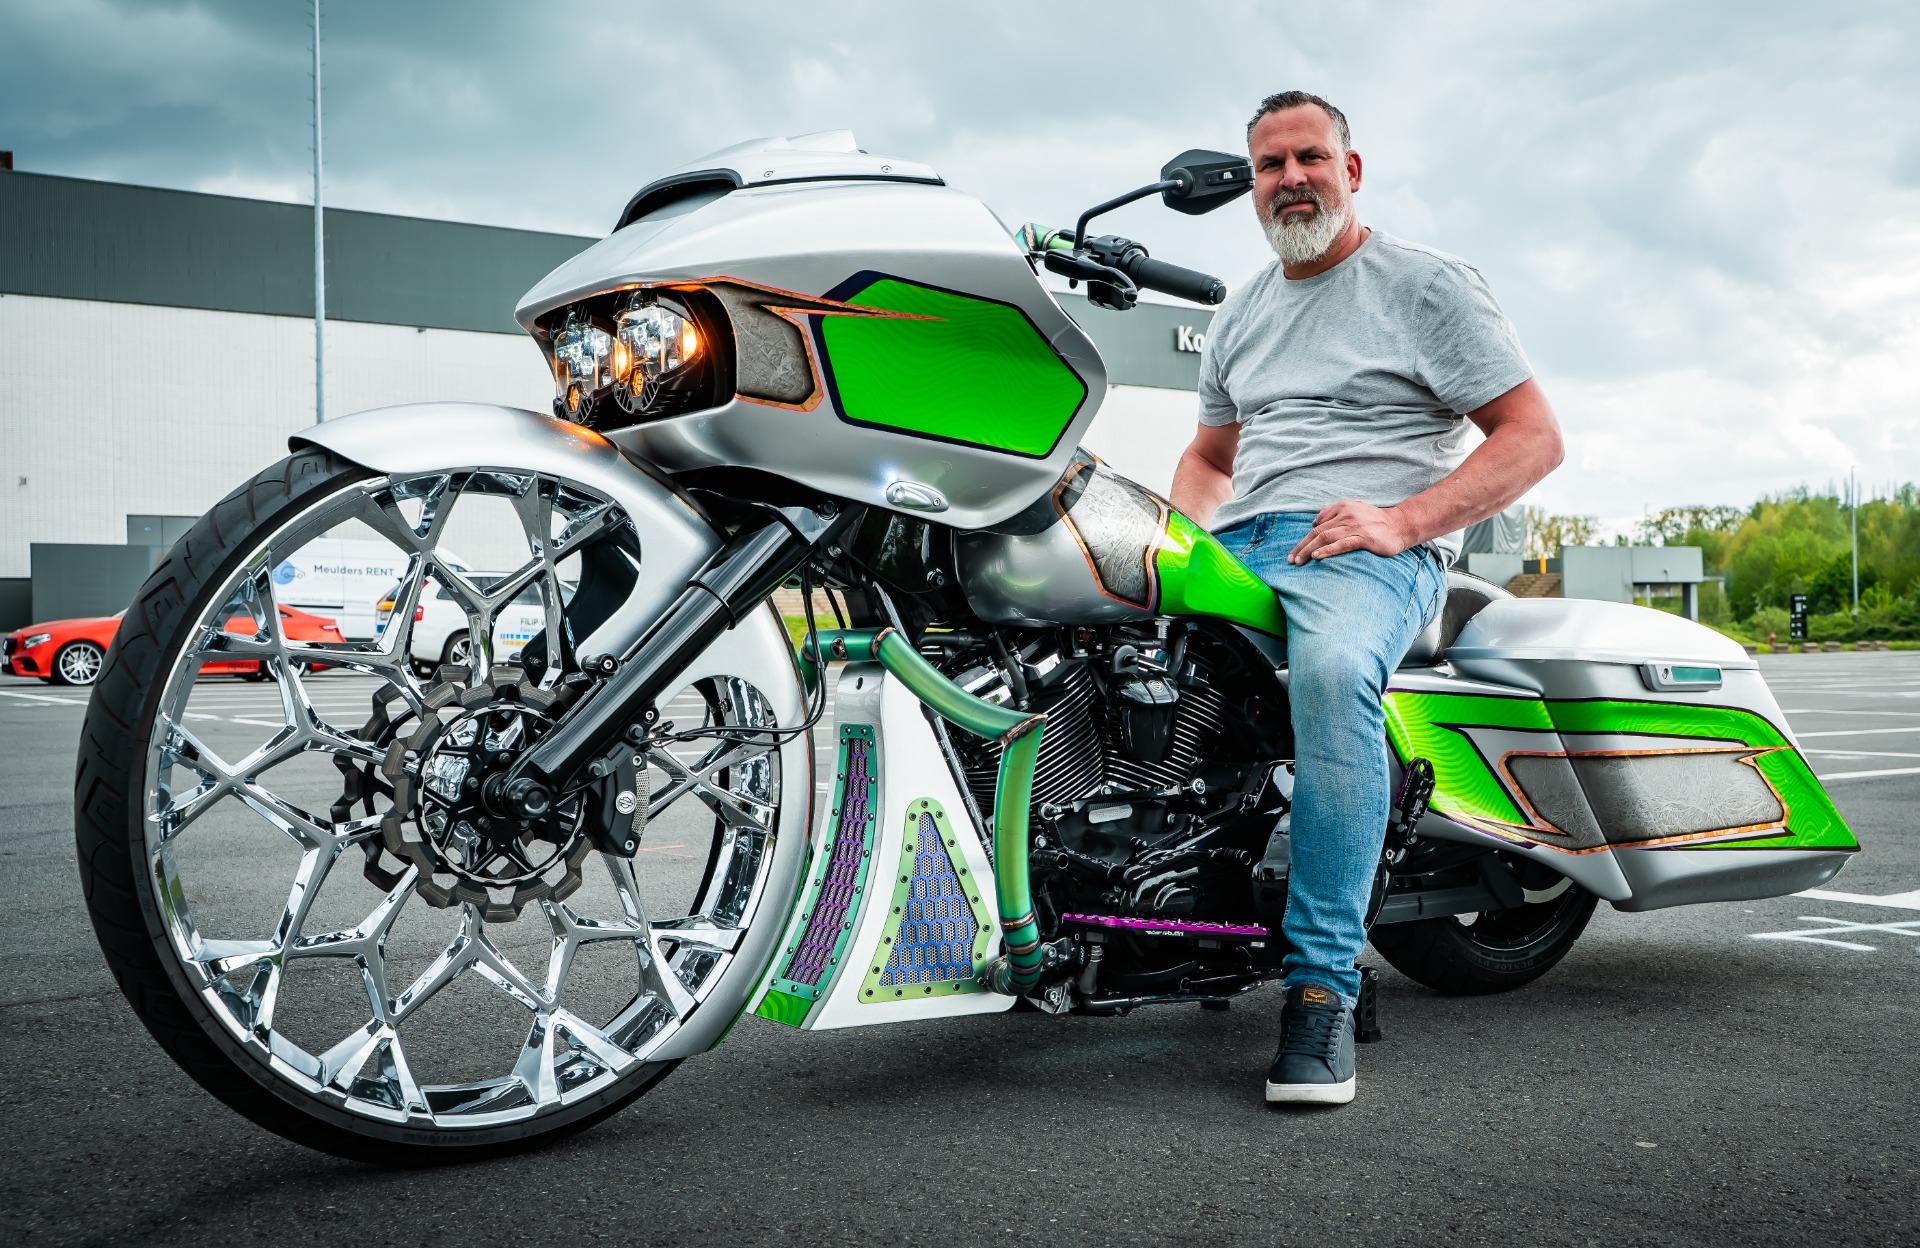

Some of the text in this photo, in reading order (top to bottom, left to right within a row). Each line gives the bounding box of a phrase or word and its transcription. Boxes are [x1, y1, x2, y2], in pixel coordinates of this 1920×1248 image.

[314, 564, 395, 576] Meulders RENT
[520, 617, 539, 626] FILIP
